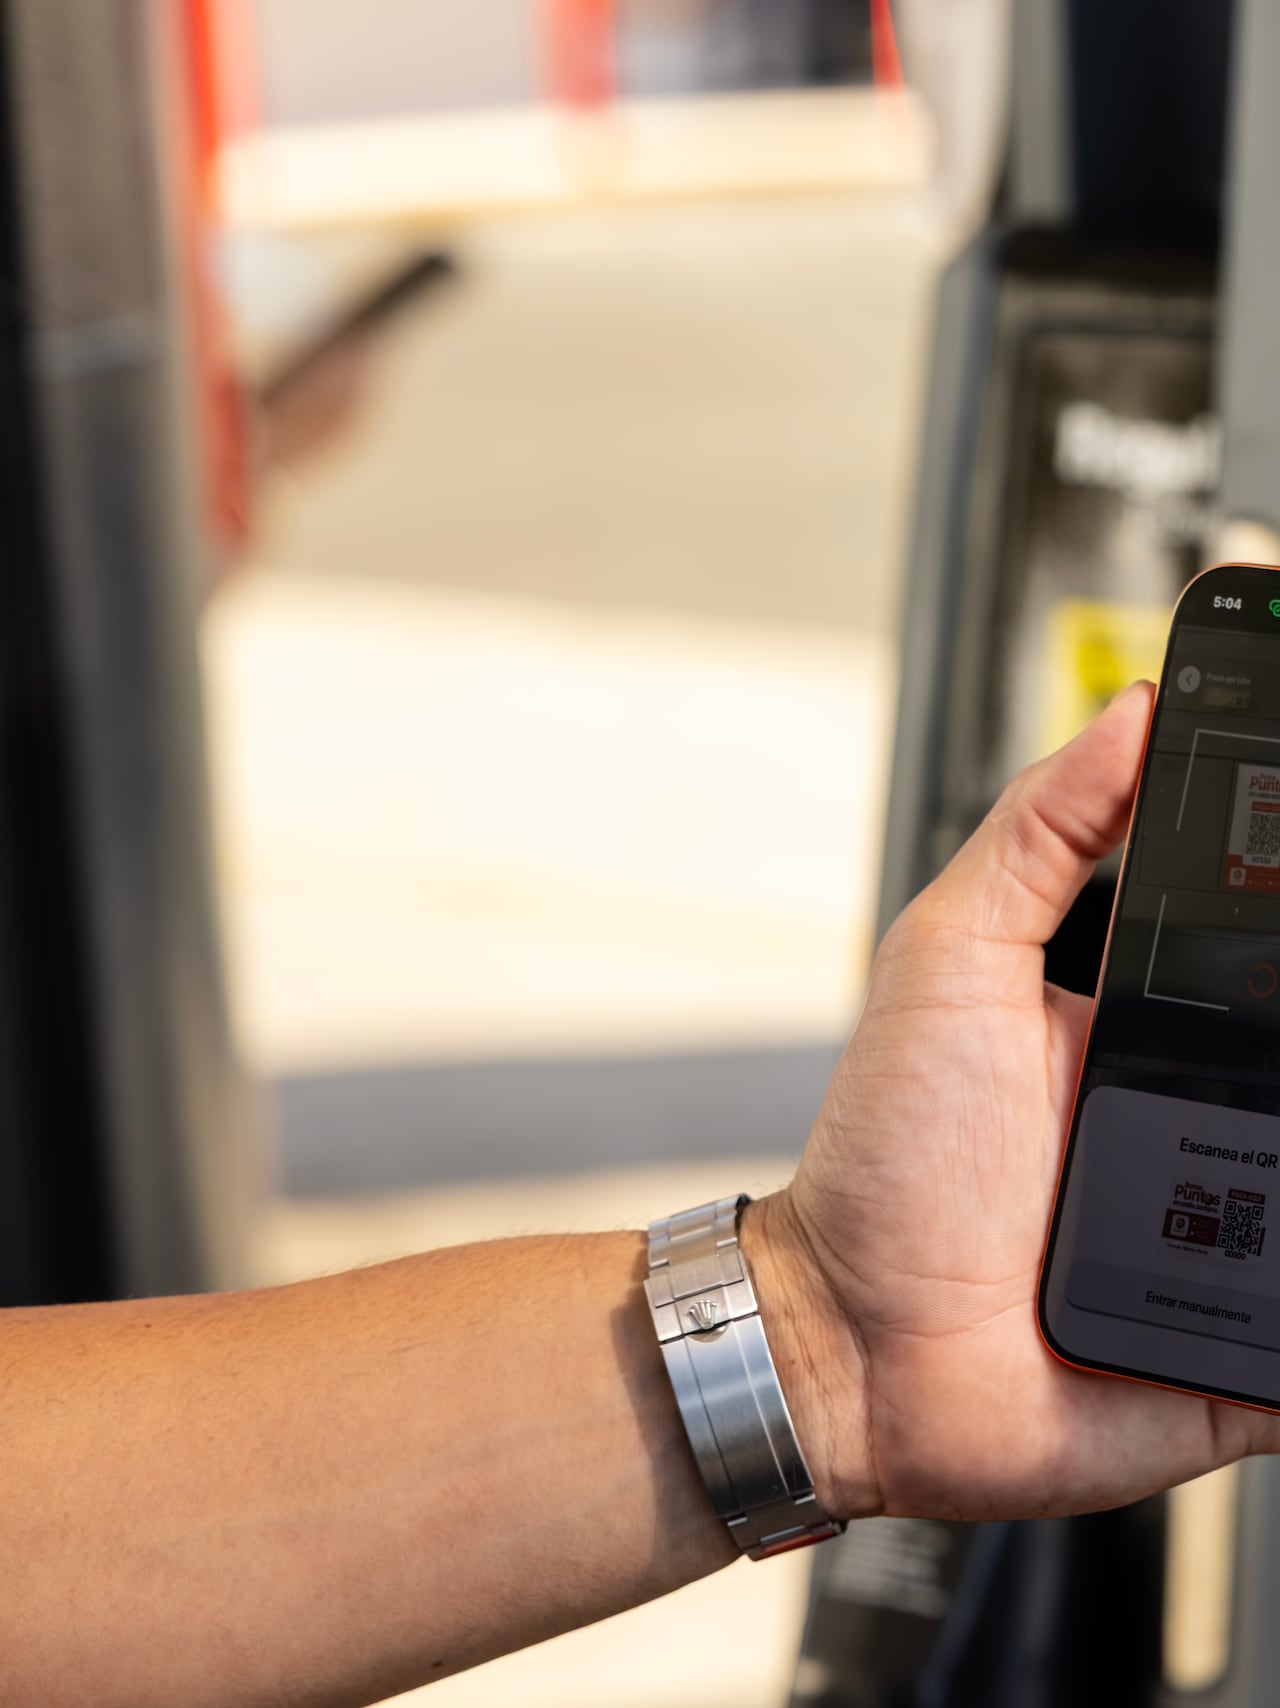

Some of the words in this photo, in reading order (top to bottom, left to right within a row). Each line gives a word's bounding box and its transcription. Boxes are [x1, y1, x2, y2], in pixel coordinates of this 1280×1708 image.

[1213, 596, 1242, 610] 5:04
[1180, 1137, 1238, 1161] Escanea
[1240, 1150, 1254, 1164] el
[1256, 1152, 1278, 1168] QR
[1174, 1184, 1221, 1206] Puntos
[1145, 1290, 1178, 1308] Entrar
[1179, 1300, 1251, 1324] manualmente
